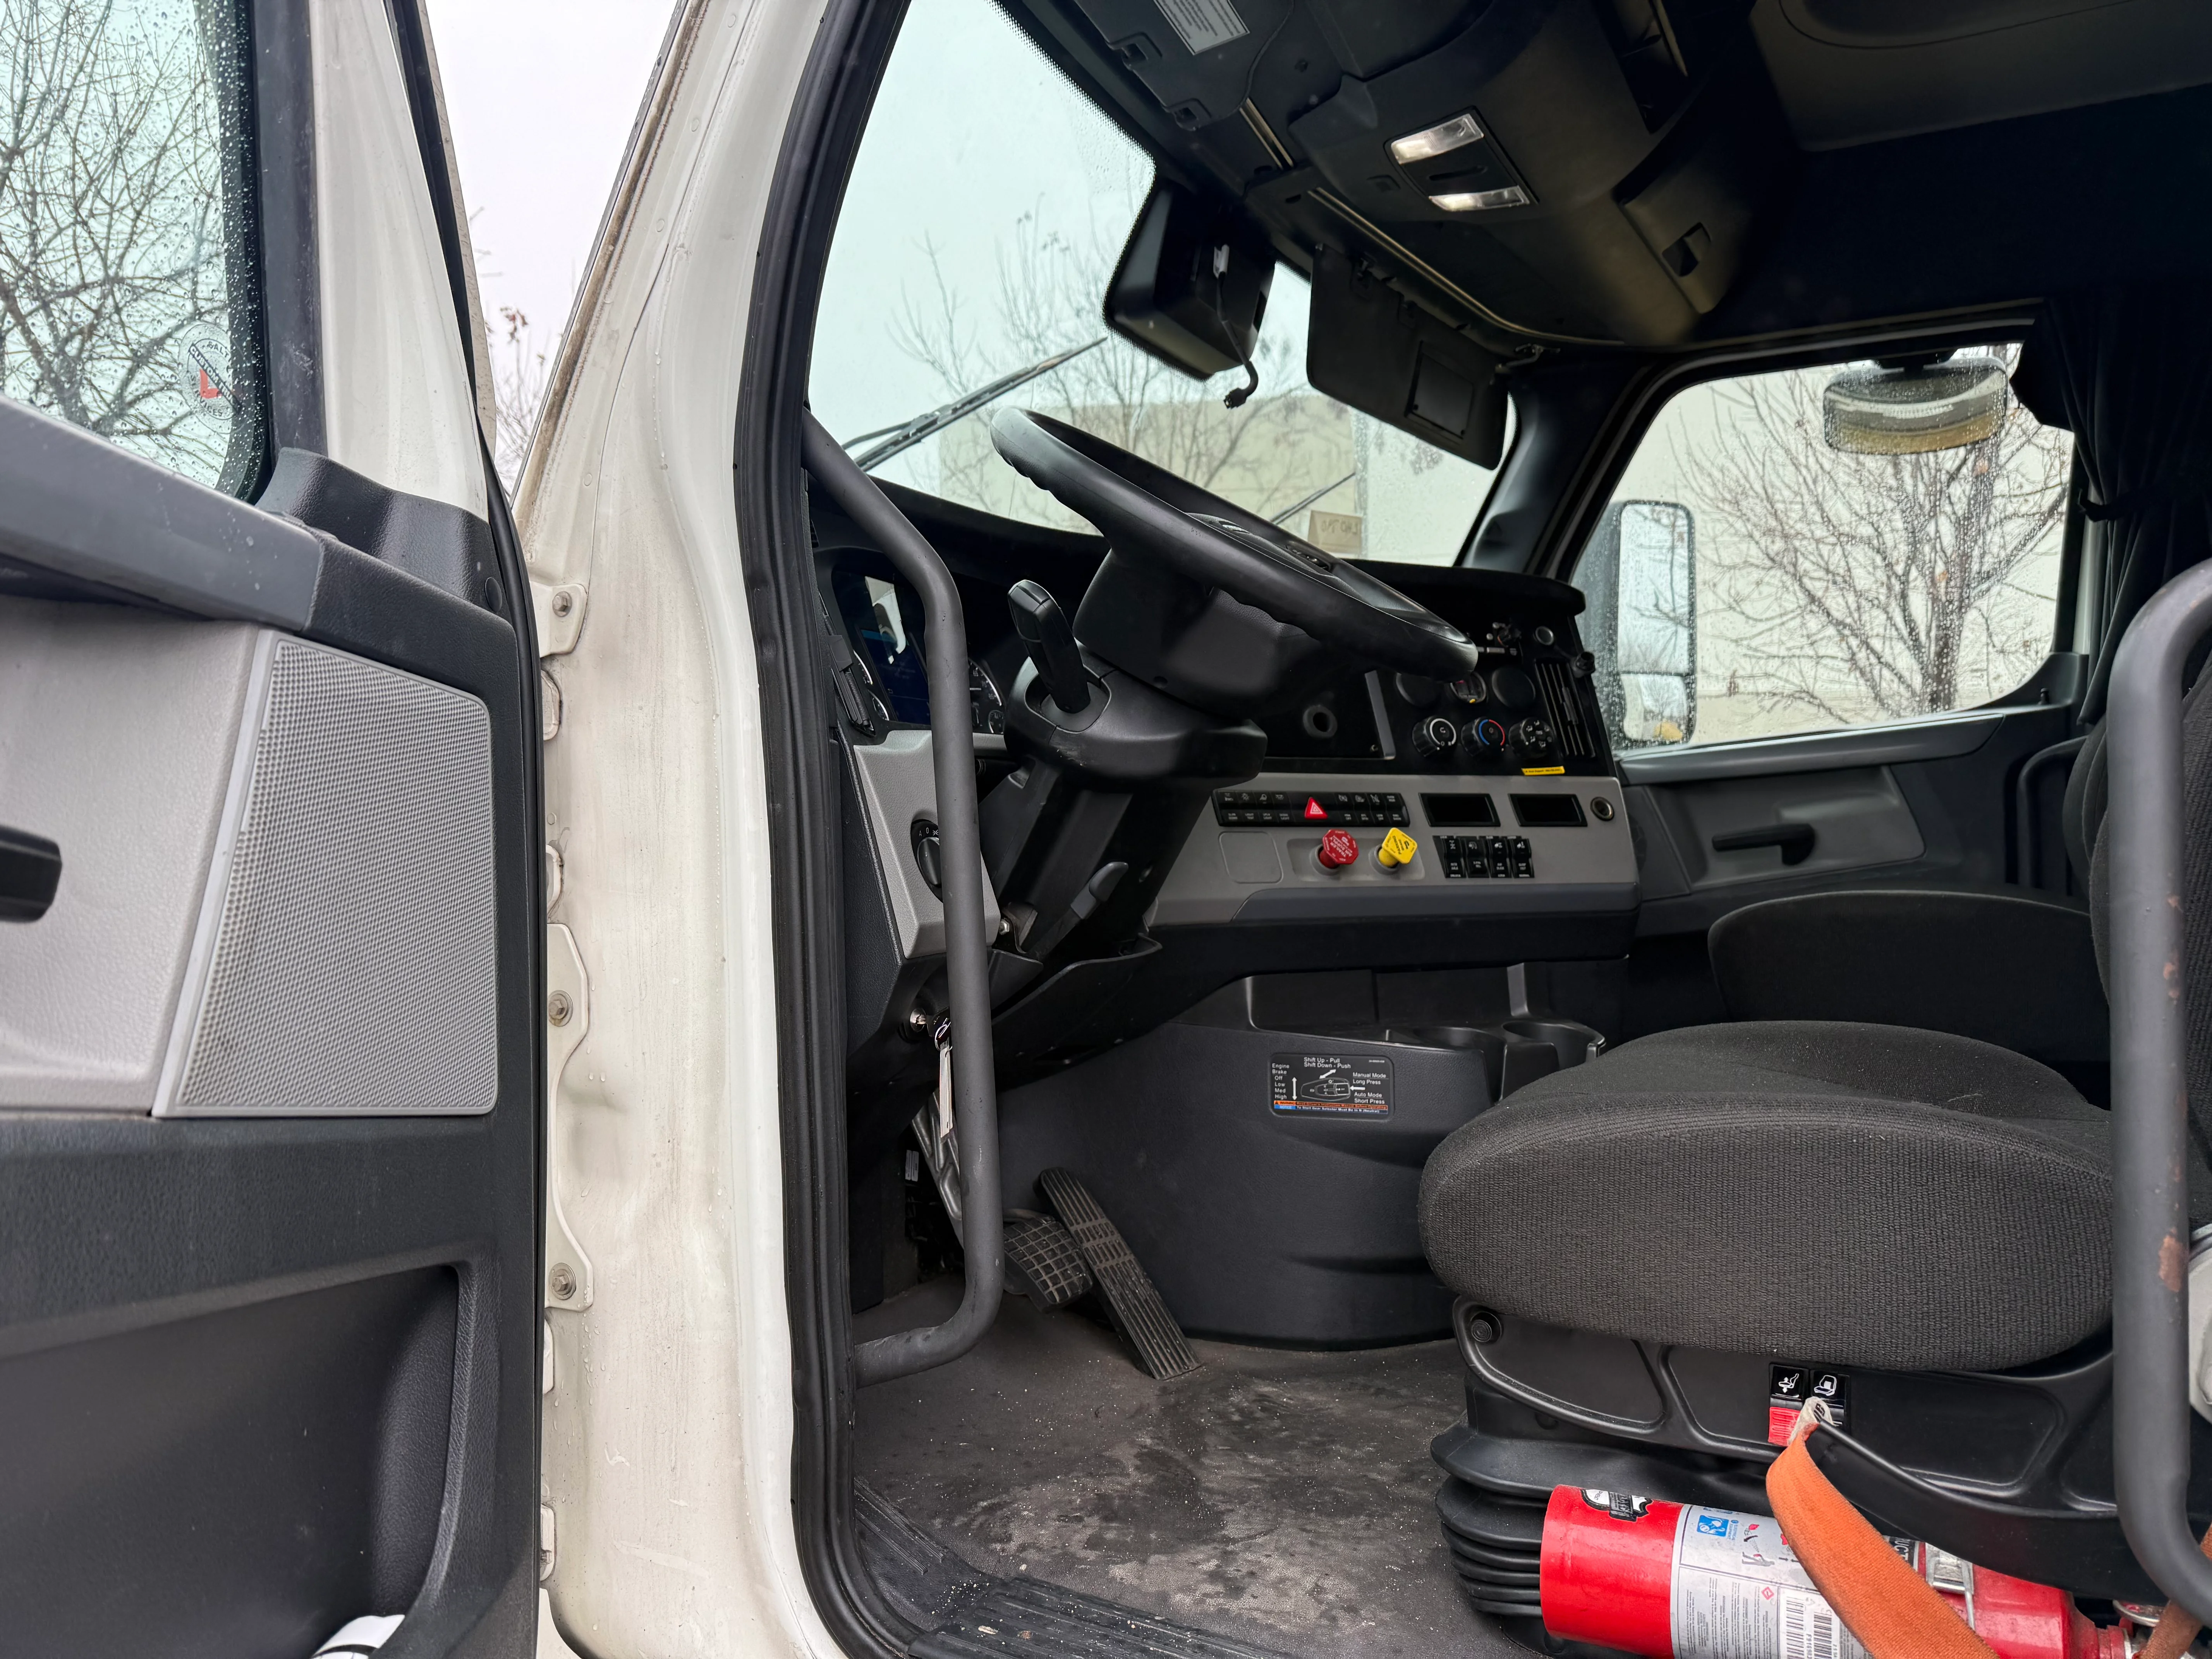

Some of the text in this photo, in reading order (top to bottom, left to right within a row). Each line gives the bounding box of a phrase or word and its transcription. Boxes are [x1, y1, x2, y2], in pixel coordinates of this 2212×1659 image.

[207, 341, 229, 357] SALT
[190, 346, 219, 383] CUSTOM
[1329, 836, 1346, 851] SUPPLY
